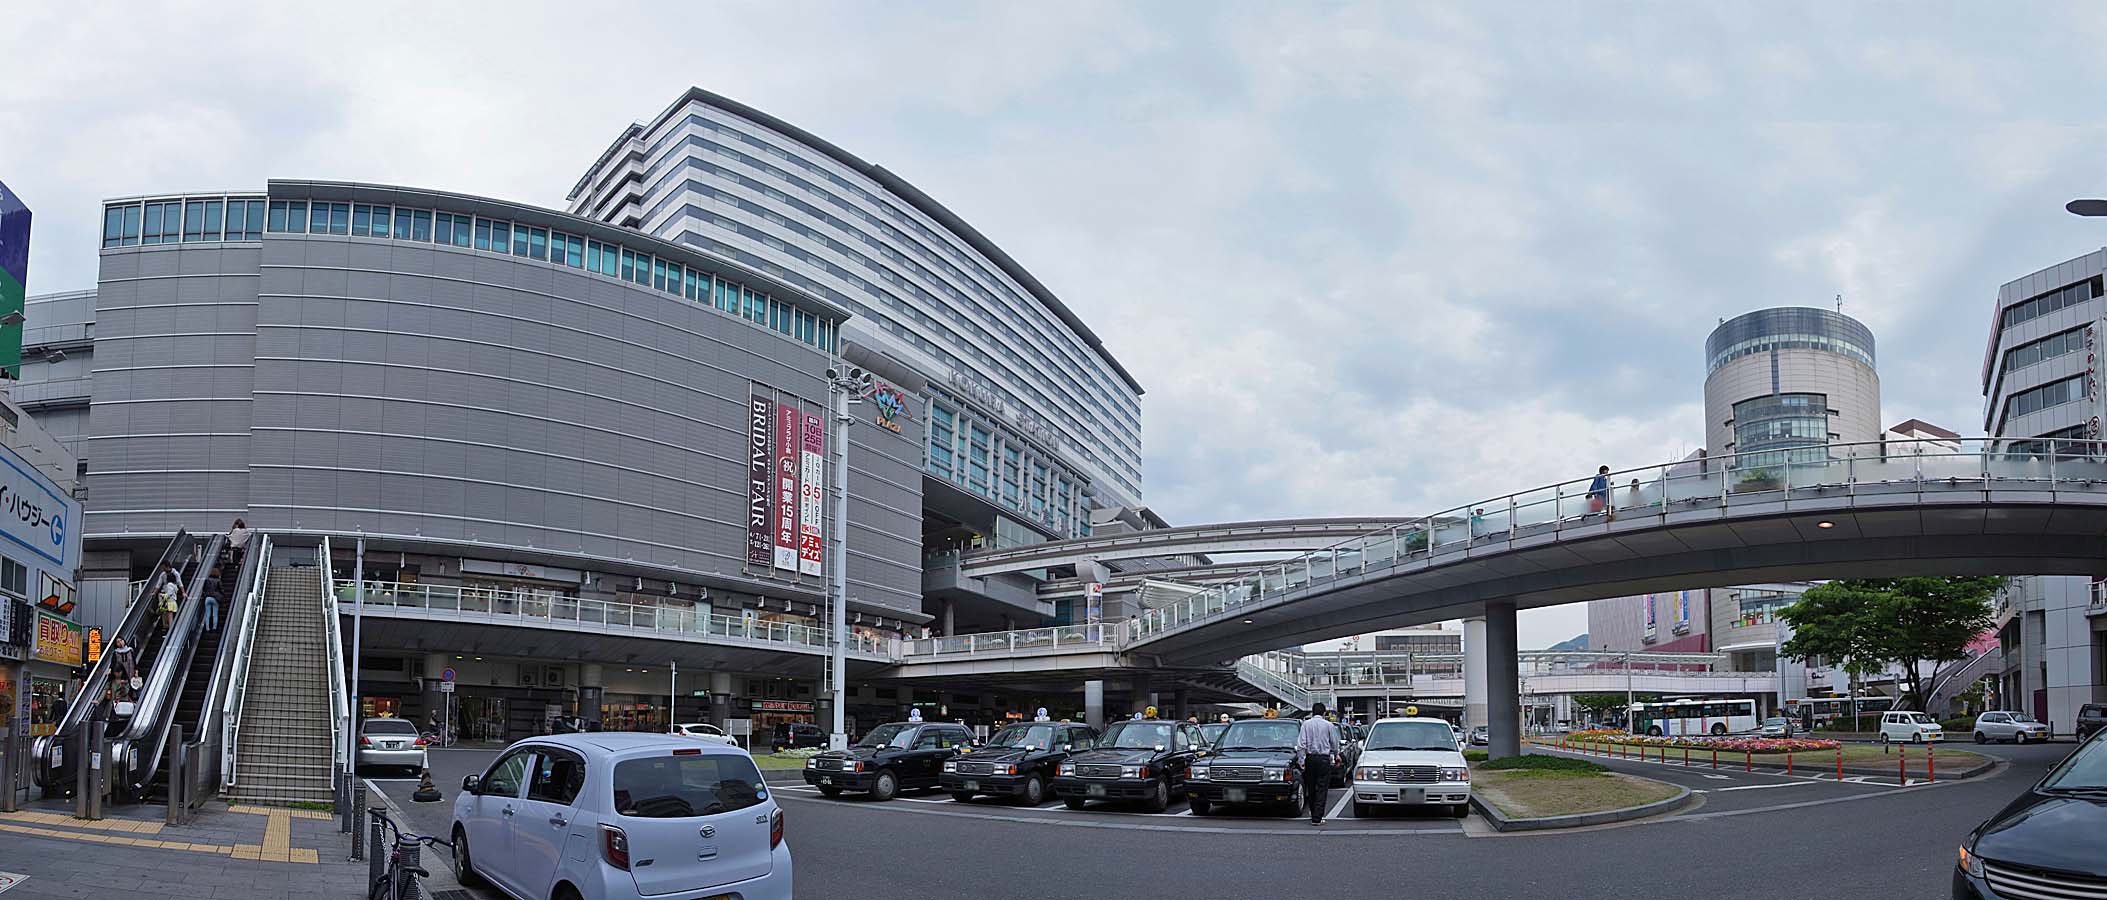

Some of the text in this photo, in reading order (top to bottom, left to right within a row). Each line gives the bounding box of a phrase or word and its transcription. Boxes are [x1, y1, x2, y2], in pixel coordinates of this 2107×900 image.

[804, 424, 822, 437] 10日
[804, 433, 822, 446] 25日
[752, 400, 766, 526] BRIDAL FAIR
[783, 459, 794, 473] 祝
[781, 477, 793, 543] 開業15周年
[801, 535, 820, 548] アミュ
[801, 547, 821, 560] デイズ
[41, 616, 69, 647] 買取り
